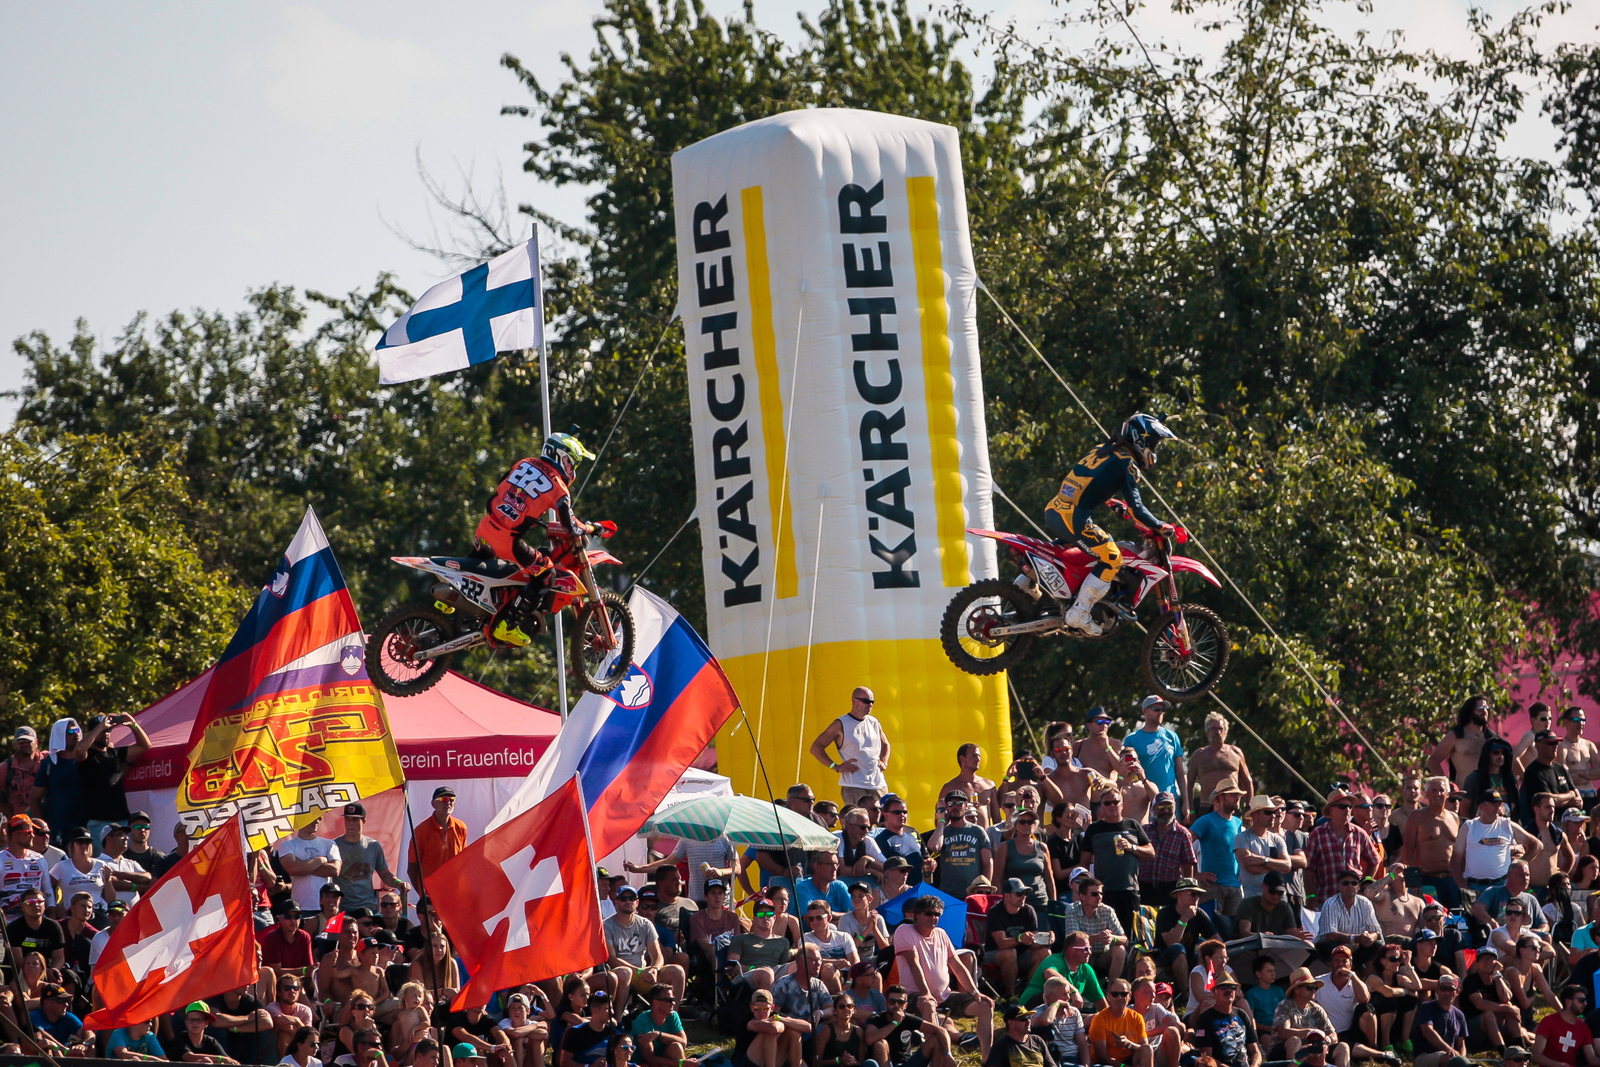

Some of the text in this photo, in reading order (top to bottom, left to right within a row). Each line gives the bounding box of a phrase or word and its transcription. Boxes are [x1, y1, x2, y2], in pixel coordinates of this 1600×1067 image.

[693, 192, 762, 608] KÄRCHER
[838, 179, 920, 589] KÄRCHER
[507, 461, 553, 500] 222
[496, 504, 519, 521] KTM
[461, 577, 485, 605] 222
[446, 747, 535, 767] Frauenfeld
